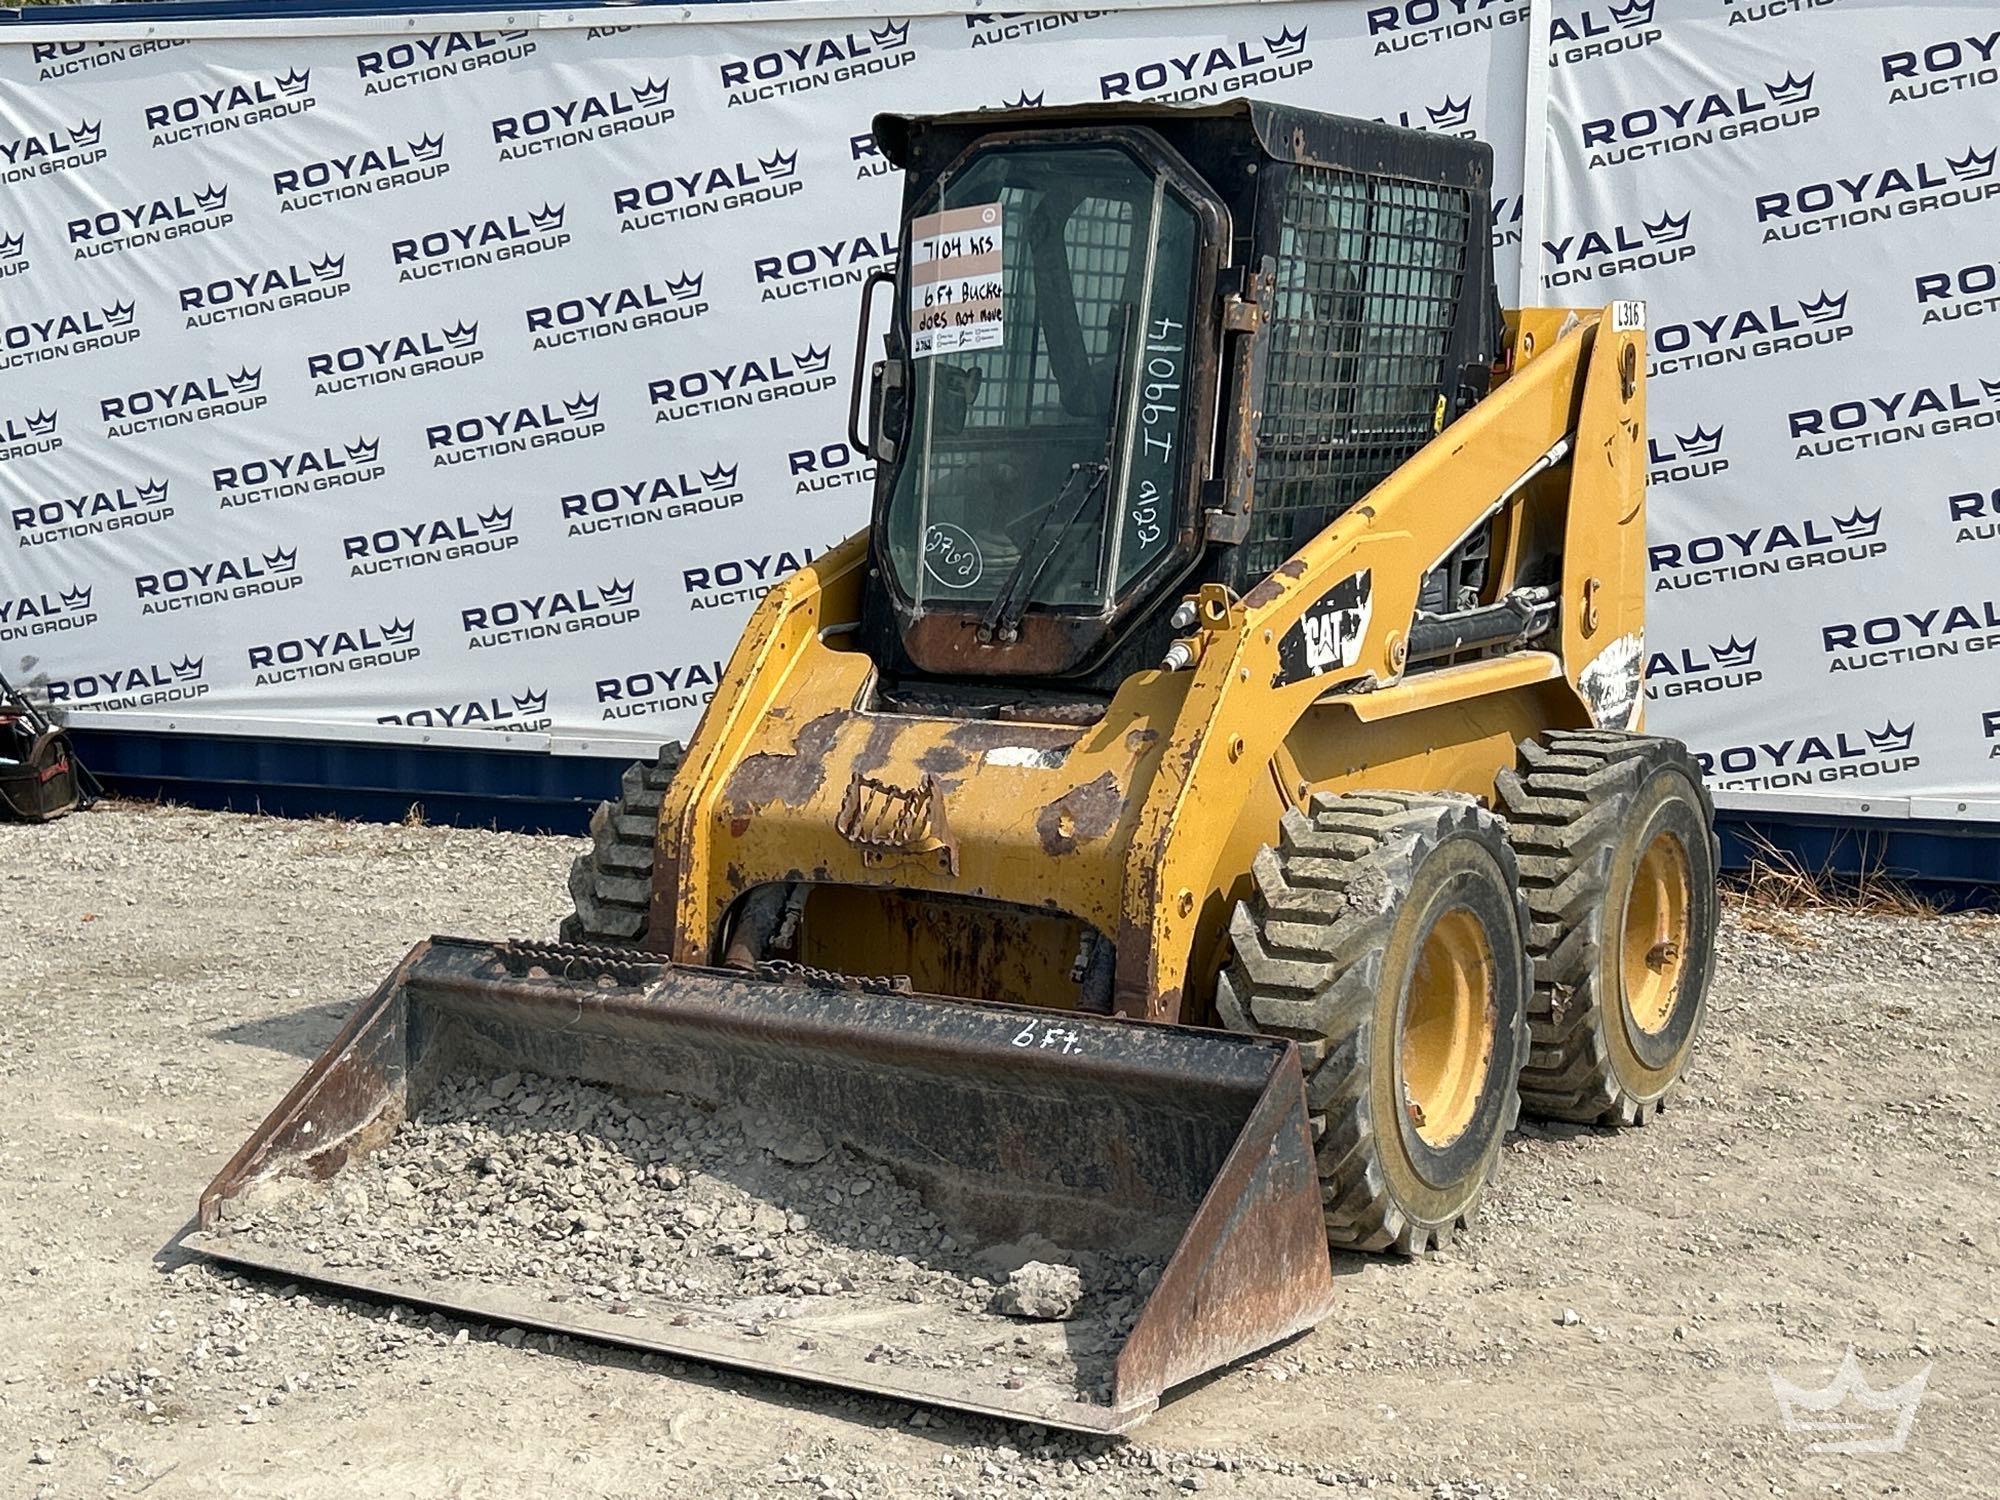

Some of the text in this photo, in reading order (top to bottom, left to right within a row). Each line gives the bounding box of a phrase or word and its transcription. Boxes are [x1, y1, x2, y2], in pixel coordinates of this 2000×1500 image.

[971, 12, 1078, 48] AUCTION
[1374, 15, 1493, 56] AUCTION
[1565, 30, 1662, 63] GROUP
[39, 48, 124, 82] AUCTION
[356, 31, 496, 78] ROYAL
[364, 42, 536, 96] AUCTION GROUP
[720, 34, 872, 88] ROYAL
[1100, 42, 1265, 100] ROYAL
[1223, 60, 1313, 92] GROUP
[728, 51, 915, 108] AUCTION GROUP
[1889, 68, 1998, 104] AUCTIO
[145, 81, 277, 130] ROYAL
[152, 98, 315, 148] AUCTION GROUP
[492, 91, 633, 144] ROYAL
[1582, 88, 1766, 148] ROYAL
[499, 109, 675, 162] AUCTION GROUP
[1589, 107, 1820, 170] AUCTION GROUP
[39, 149, 107, 175] GROUP
[273, 146, 410, 195] ROYAL
[281, 163, 449, 213] AUCTION GROUP
[614, 163, 760, 214] ROYAL
[621, 181, 803, 233] AUCTION GROUP
[1755, 163, 1947, 223] ROYAL
[68, 196, 195, 243] ROYAL
[1762, 183, 2000, 244] AUCTION GROUP
[74, 214, 233, 261] AUCTION GROUP
[392, 216, 531, 265] ROYAL
[399, 234, 570, 283] AUCTION GROUP
[754, 232, 899, 283] ROYAL
[923, 236, 994, 261] 7104 hrs
[1542, 226, 1644, 265] YAL
[1598, 245, 1695, 278] GROUP
[179, 265, 312, 311] ROYAL
[186, 283, 350, 329] AUCTION GROUP
[761, 269, 862, 302] AUCTION
[925, 286, 934, 307] 6
[937, 284, 952, 304] Ft
[0, 311, 104, 349] OYAL
[526, 284, 667, 333] ROYAL
[533, 303, 709, 351] AUCTION GROUP
[920, 310, 947, 331] does
[956, 309, 974, 326] not
[1653, 305, 1800, 353] OYAL
[72, 329, 140, 353] GROUP
[308, 333, 444, 378] ROYAL
[1752, 326, 1853, 356] GROUP
[315, 351, 484, 396] AUCTION GROUP
[648, 357, 794, 405] ROYAL
[100, 378, 229, 422] ROYAL
[108, 396, 267, 439] AUCTION GROUP
[656, 376, 836, 423] AUCTION GROUP
[1788, 383, 1980, 438] ROYAL
[426, 404, 565, 449] ROYAL
[434, 423, 605, 467] AUCTION GROUP
[1795, 410, 2000, 460] AUCTION GRO
[0, 438, 62, 461] GROUP
[212, 448, 346, 491] ROYAL
[220, 467, 385, 509] AUCTION GROUP
[796, 468, 876, 494] AUCTIO
[1645, 459, 1729, 487] ROUP
[11, 488, 138, 531] ROYAL
[561, 474, 702, 519] ROYAL
[568, 493, 743, 537] AUCTION GROUP
[19, 508, 174, 548] AUCTION GROUP
[343, 517, 479, 560] ROYAL
[1648, 520, 1833, 572] ROYAL
[351, 536, 519, 577] AUCTION GROUP
[926, 532, 974, 575] 2762
[1655, 542, 1887, 592] AUCTION GROUP
[135, 557, 264, 598] ROYAL
[142, 576, 303, 615] AUCTION GROUP
[31, 613, 97, 635] GROUP
[462, 590, 600, 632] ROYAL
[469, 609, 640, 650] AUCTION GROUP
[1822, 601, 2000, 652] ROYAL
[248, 628, 381, 669] ROYAL
[1306, 610, 1342, 668] CAT
[1829, 641, 1958, 673] AUCTION
[46, 665, 172, 702] ROYAL
[255, 647, 420, 687] AUCTION GROUP
[1664, 671, 1762, 697] GROUP
[141, 684, 209, 706] GROUP
[602, 694, 698, 721] AUCTION
[1819, 756, 1920, 782] GROUP
[1012, 1019, 1038, 1047] 6
